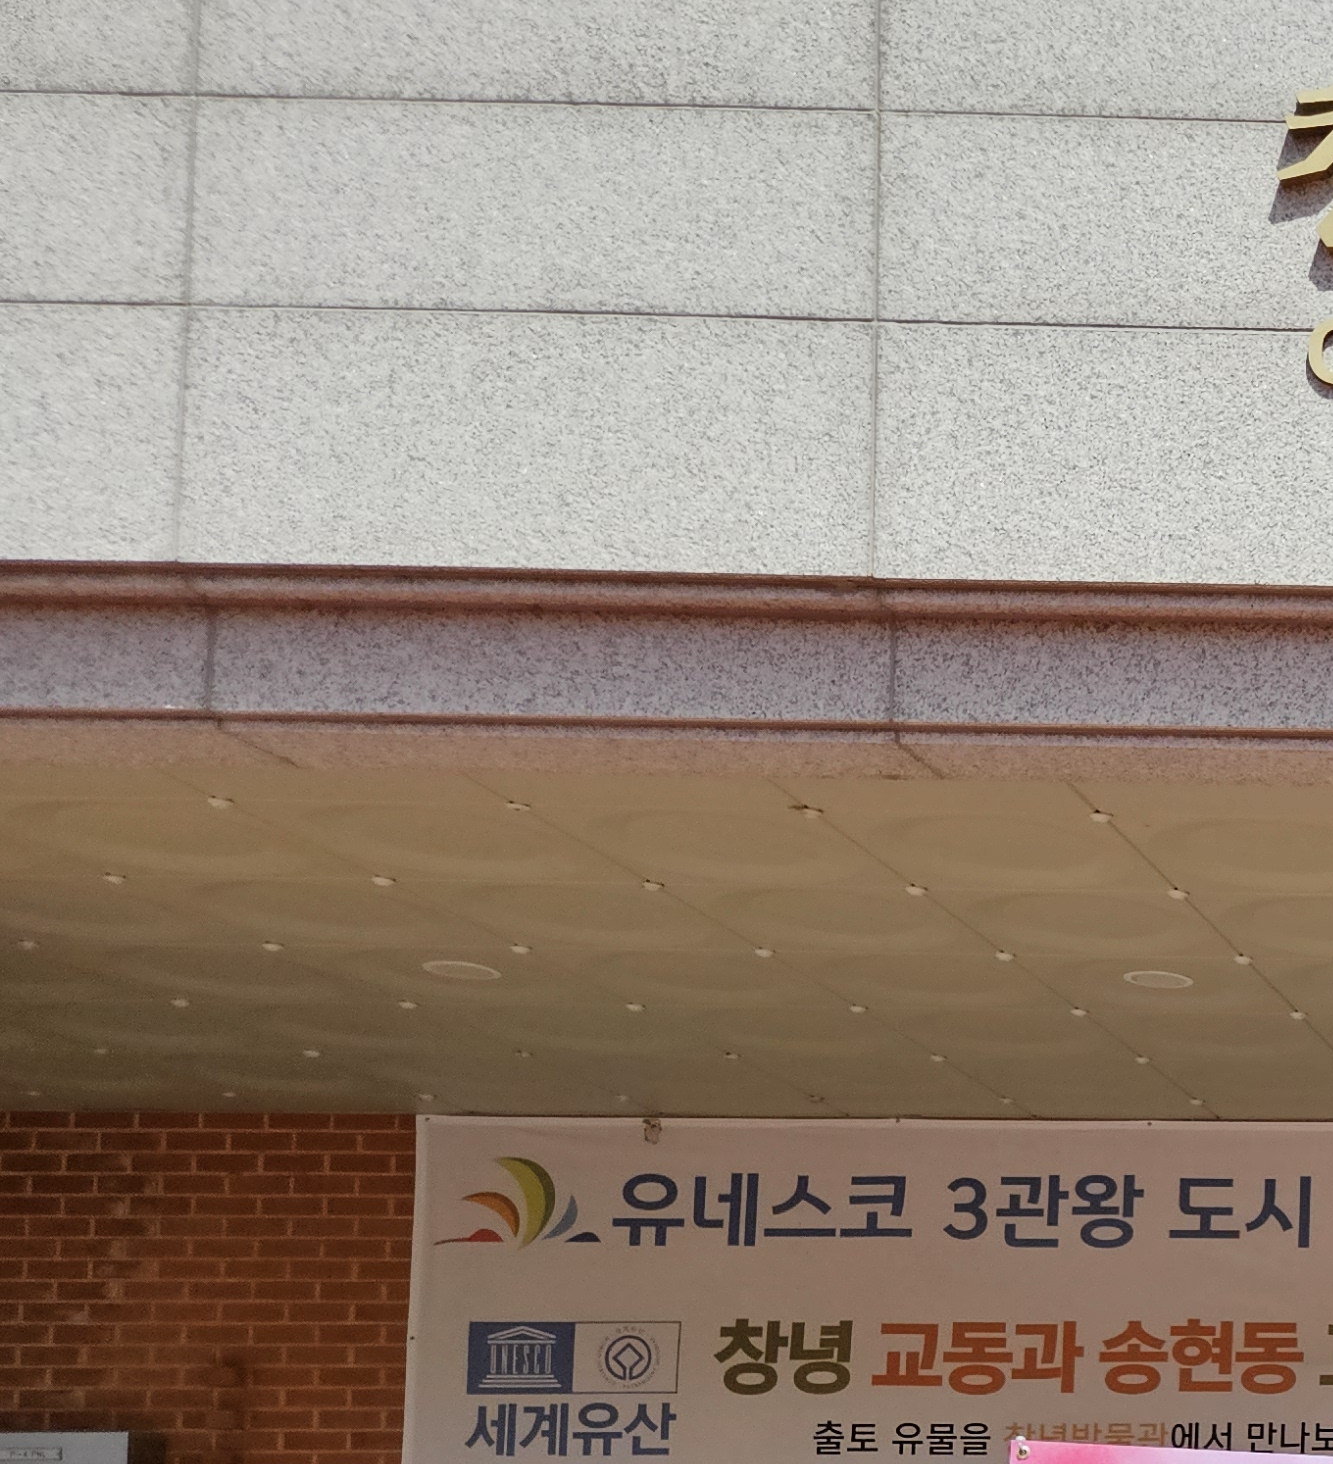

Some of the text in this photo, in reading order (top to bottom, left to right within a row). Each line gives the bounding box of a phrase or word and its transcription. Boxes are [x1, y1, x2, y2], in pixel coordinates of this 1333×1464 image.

[611, 1172, 914, 1248] 유네스코
[943, 1173, 1145, 1249] 3관왕
[1168, 1174, 1313, 1248] 도시
[490, 1344, 551, 1375] UNESCO
[714, 1317, 853, 1396] 창녕
[871, 1320, 1088, 1395] 교동과
[1100, 1319, 1304, 1396] 송현동
[465, 1402, 677, 1457] 세계유산
[813, 1420, 879, 1456] 출토
[892, 1420, 991, 1456] 유물을
